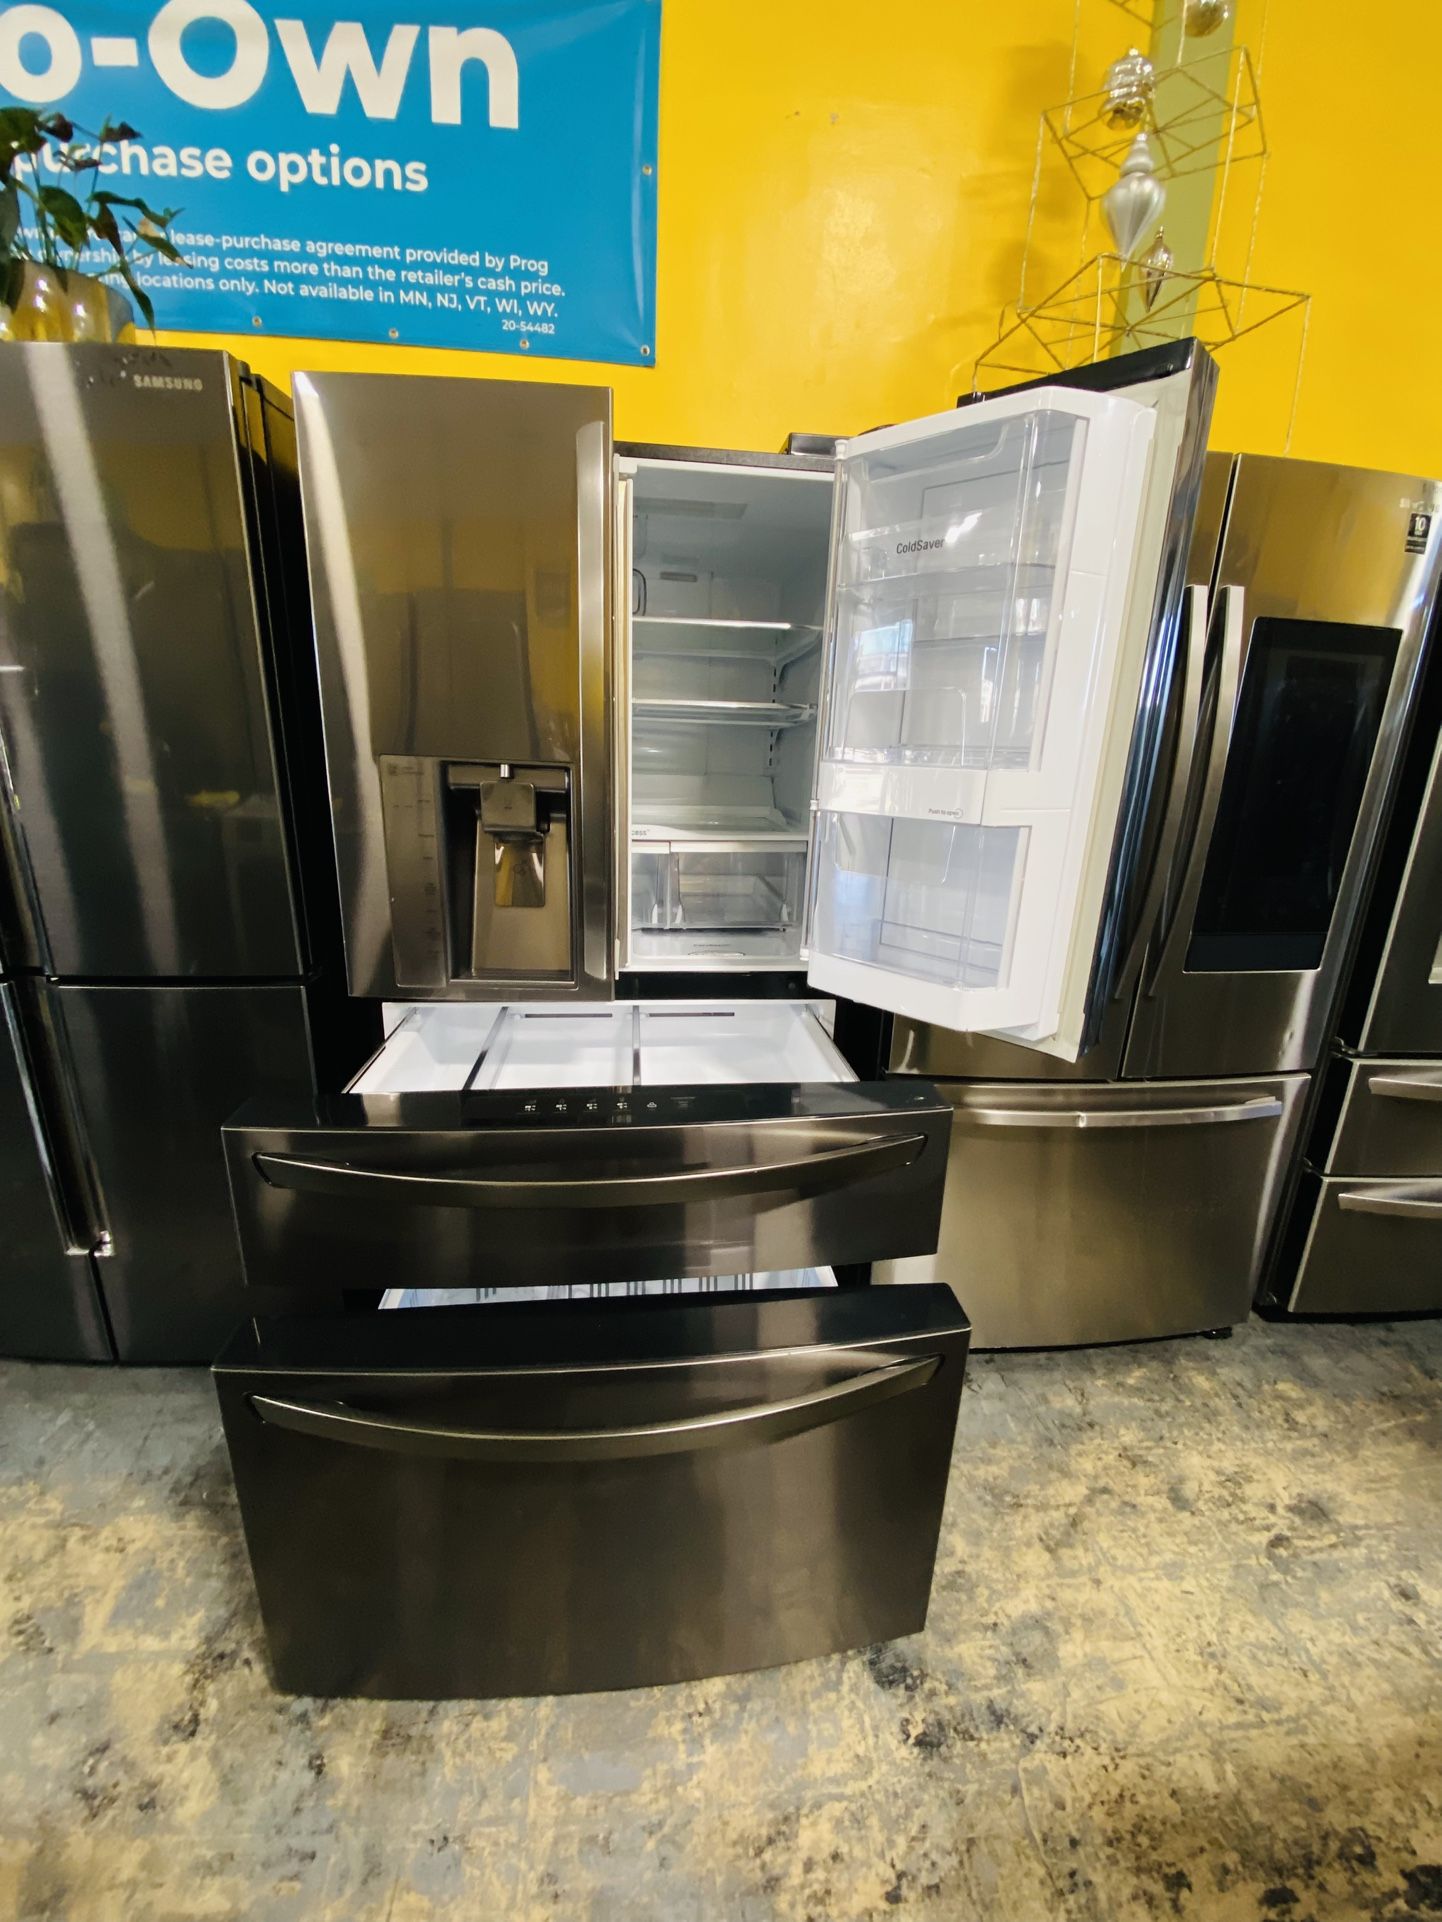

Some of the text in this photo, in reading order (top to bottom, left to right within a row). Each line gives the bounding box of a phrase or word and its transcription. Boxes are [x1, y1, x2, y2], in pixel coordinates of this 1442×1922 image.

[247, 143, 428, 192] options
[170, 229, 301, 251] lease-purchase
[306, 239, 401, 259] agreement
[405, 248, 480, 267] provided
[485, 252, 504, 272] by
[510, 255, 548, 276] Prog
[136, 271, 214, 290] locations
[219, 277, 259, 296] only.
[264, 279, 294, 295] Not
[300, 283, 374, 302] available
[378, 286, 394, 304] in
[400, 289, 432, 309] MN,
[437, 293, 462, 312] NJ,
[465, 295, 491, 314] VT,
[495, 298, 522, 316] WI,
[526, 300, 558, 317] WY.
[224, 256, 269, 272] costs
[274, 260, 319, 276] more
[323, 262, 363, 279] than
[367, 265, 396, 282] the
[401, 269, 473, 288] retailer's
[477, 276, 515, 292] cash
[520, 279, 565, 297] price.
[502, 319, 555, 335] 20-54482
[133, 374, 203, 391] SAMSUNG
[896, 538, 945, 554] ColdSaver
